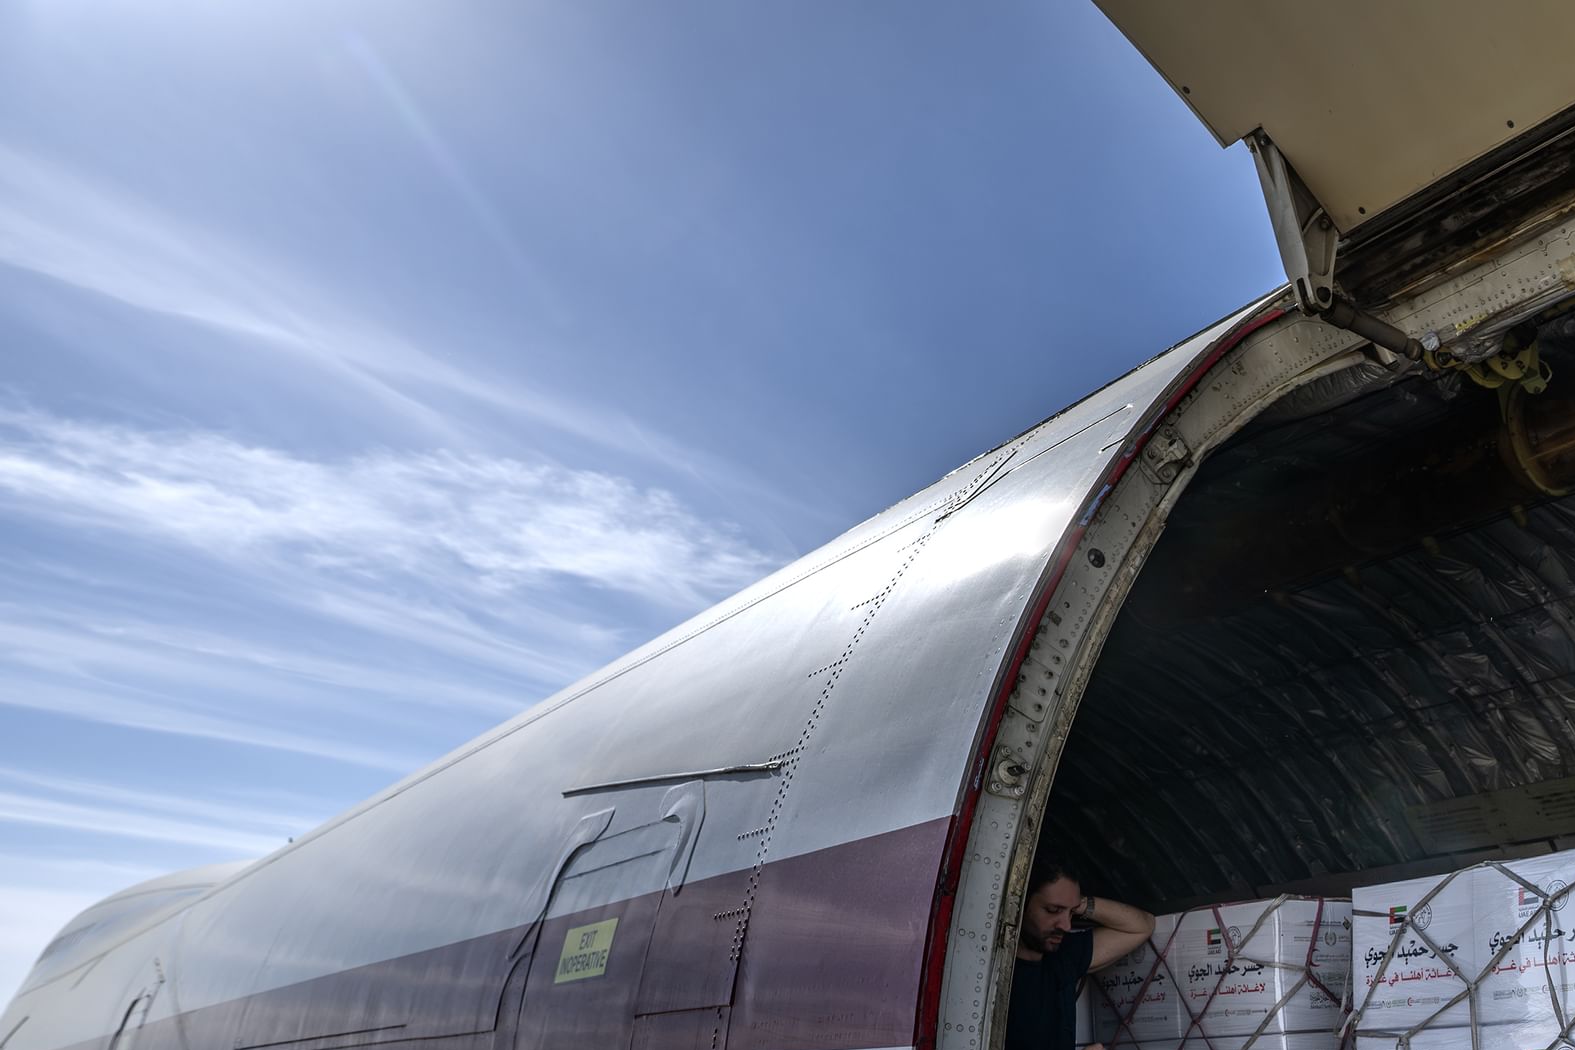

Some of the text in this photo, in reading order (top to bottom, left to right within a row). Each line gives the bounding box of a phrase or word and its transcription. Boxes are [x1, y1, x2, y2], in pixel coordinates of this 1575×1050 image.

[579, 930, 598, 950] EXIT
[560, 949, 607, 975] INOPERATIVE
[1398, 940, 1428, 965] حميد
[1188, 963, 1212, 983] الجوي
[1520, 957, 1531, 973] في
[1389, 971, 1423, 986] أهلنا في
[1238, 983, 1266, 996] لإغاثة
